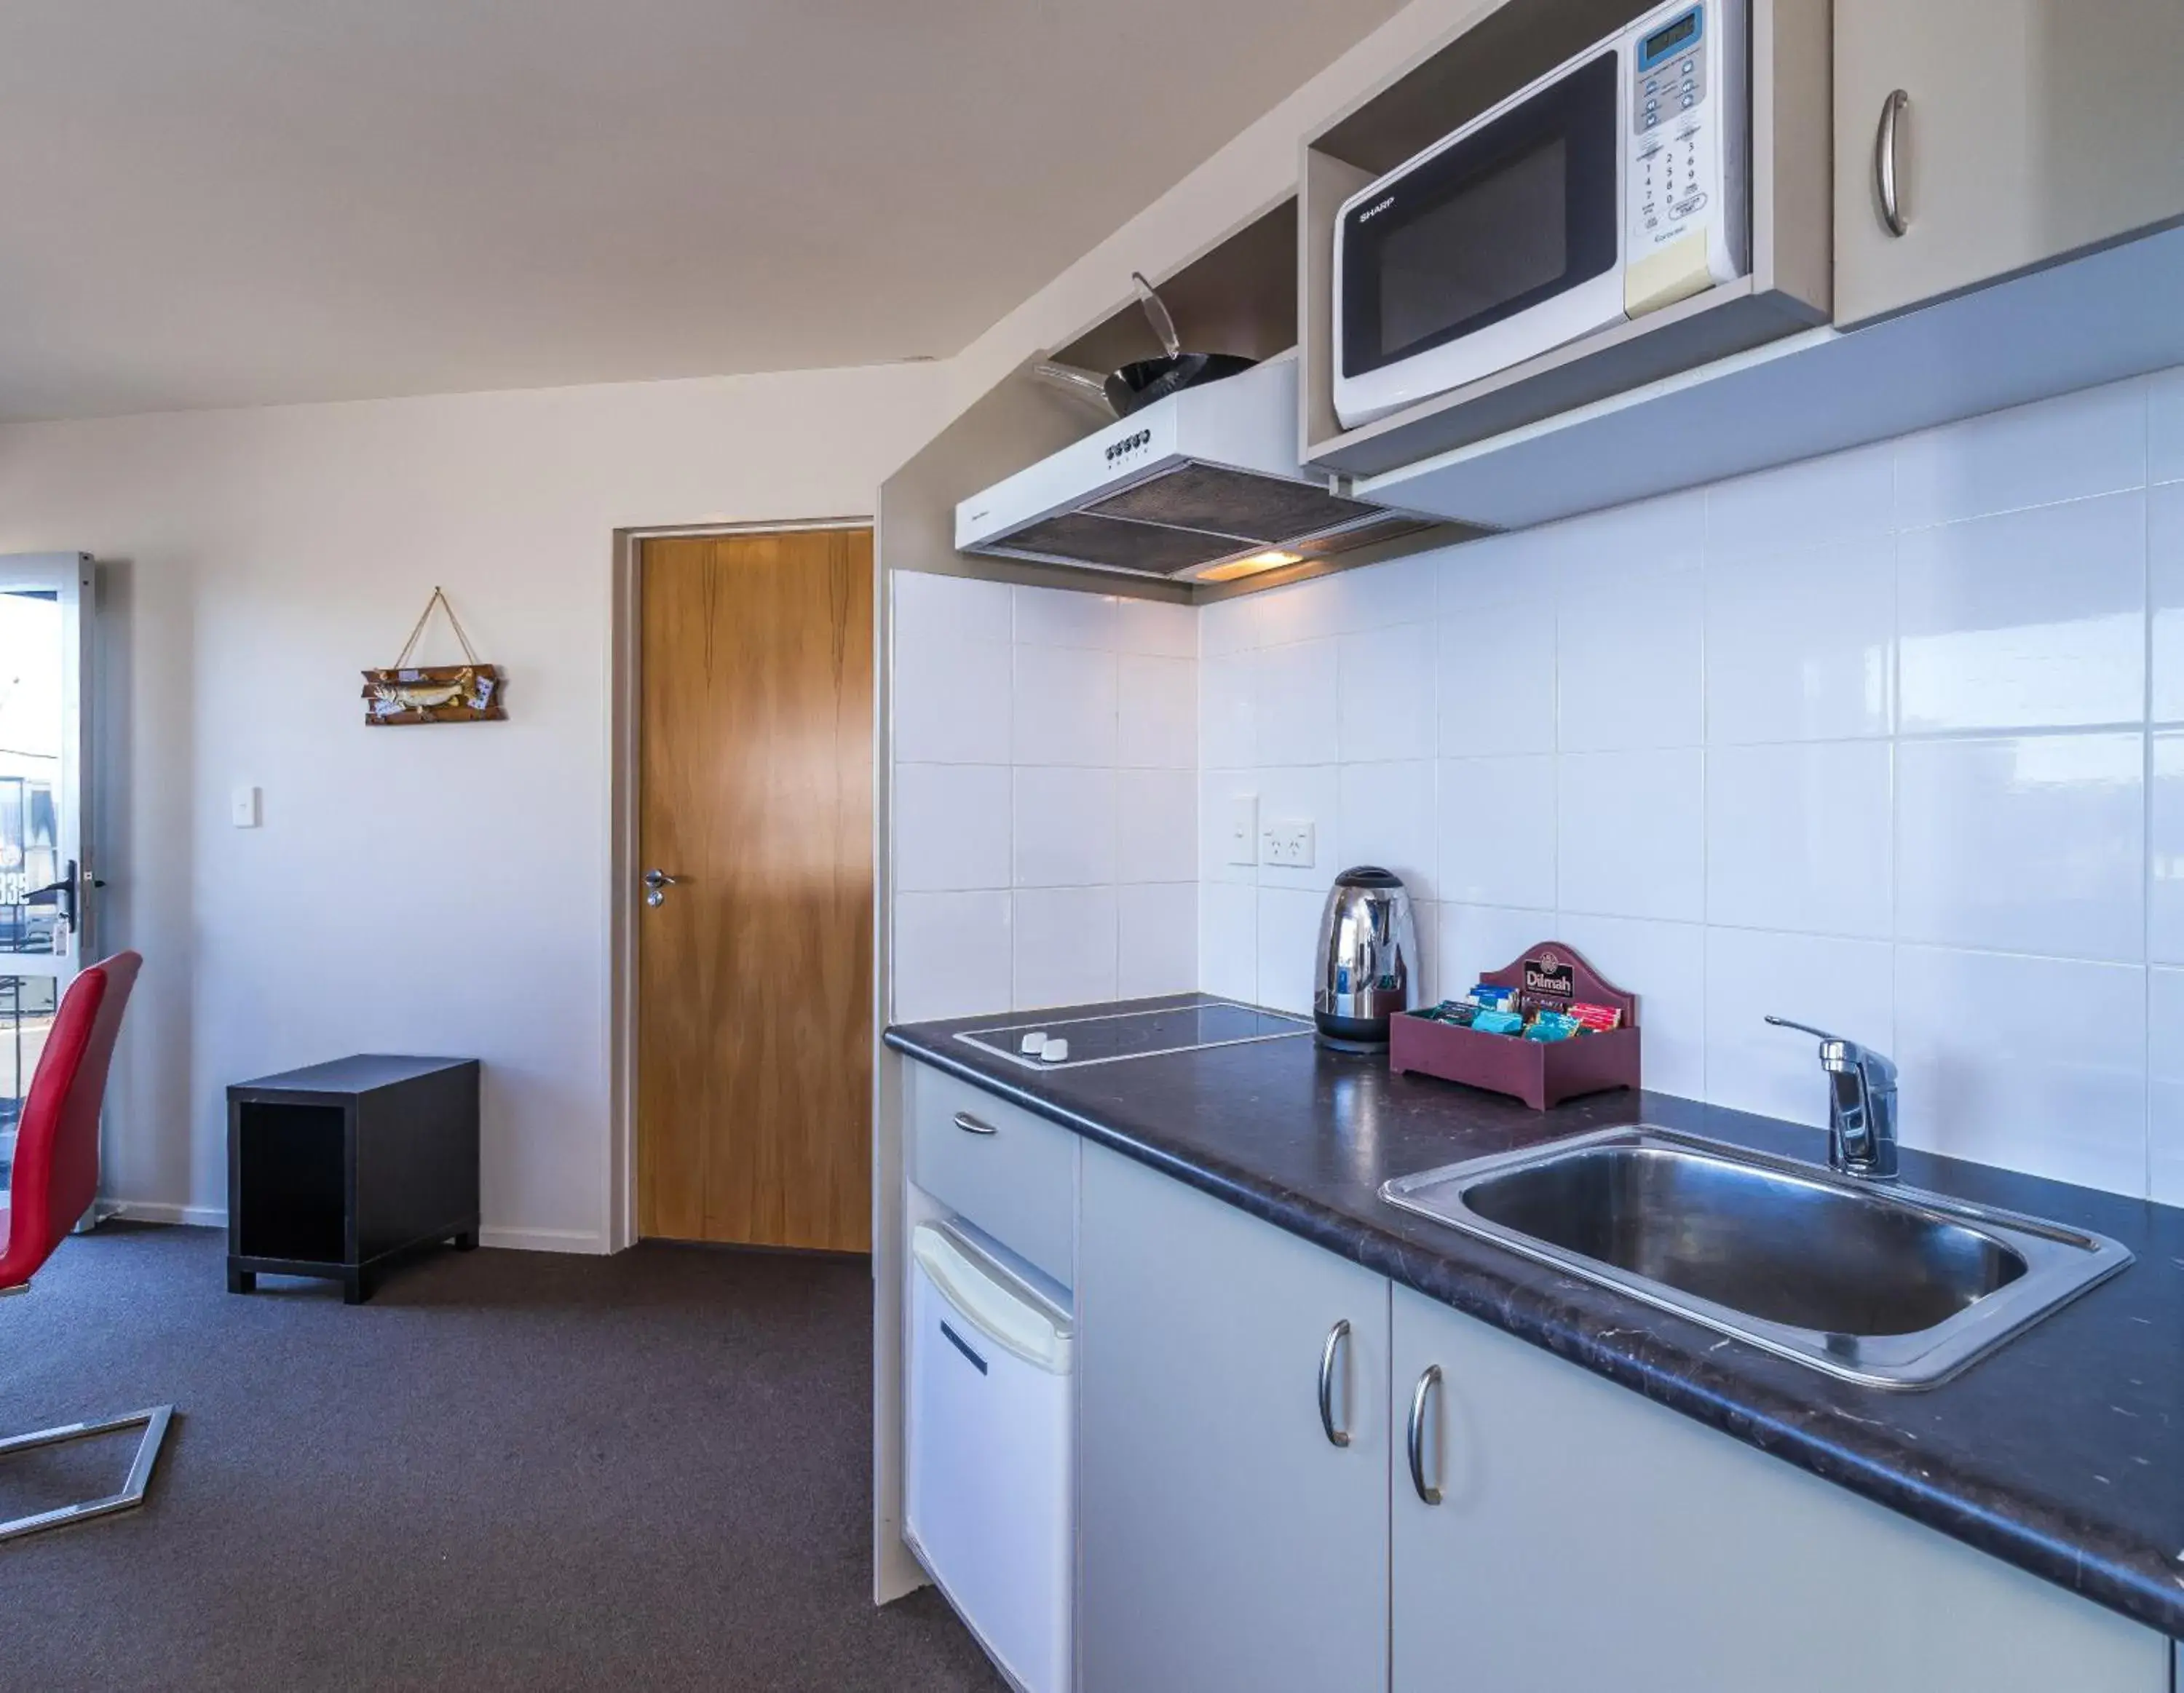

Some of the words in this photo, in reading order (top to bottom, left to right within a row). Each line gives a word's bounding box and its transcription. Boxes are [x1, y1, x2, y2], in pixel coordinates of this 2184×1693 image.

[1646, 163, 1651, 173] 1
[1666, 153, 1673, 164] 2
[1688, 142, 1695, 152] 3
[1666, 166, 1673, 178] 5
[1687, 156, 1695, 167] 6
[1688, 169, 1695, 181] 9
[1359, 197, 1395, 222] SHARP
[1666, 194, 1673, 205] 0
[1527, 970, 1571, 991] Dilmah
